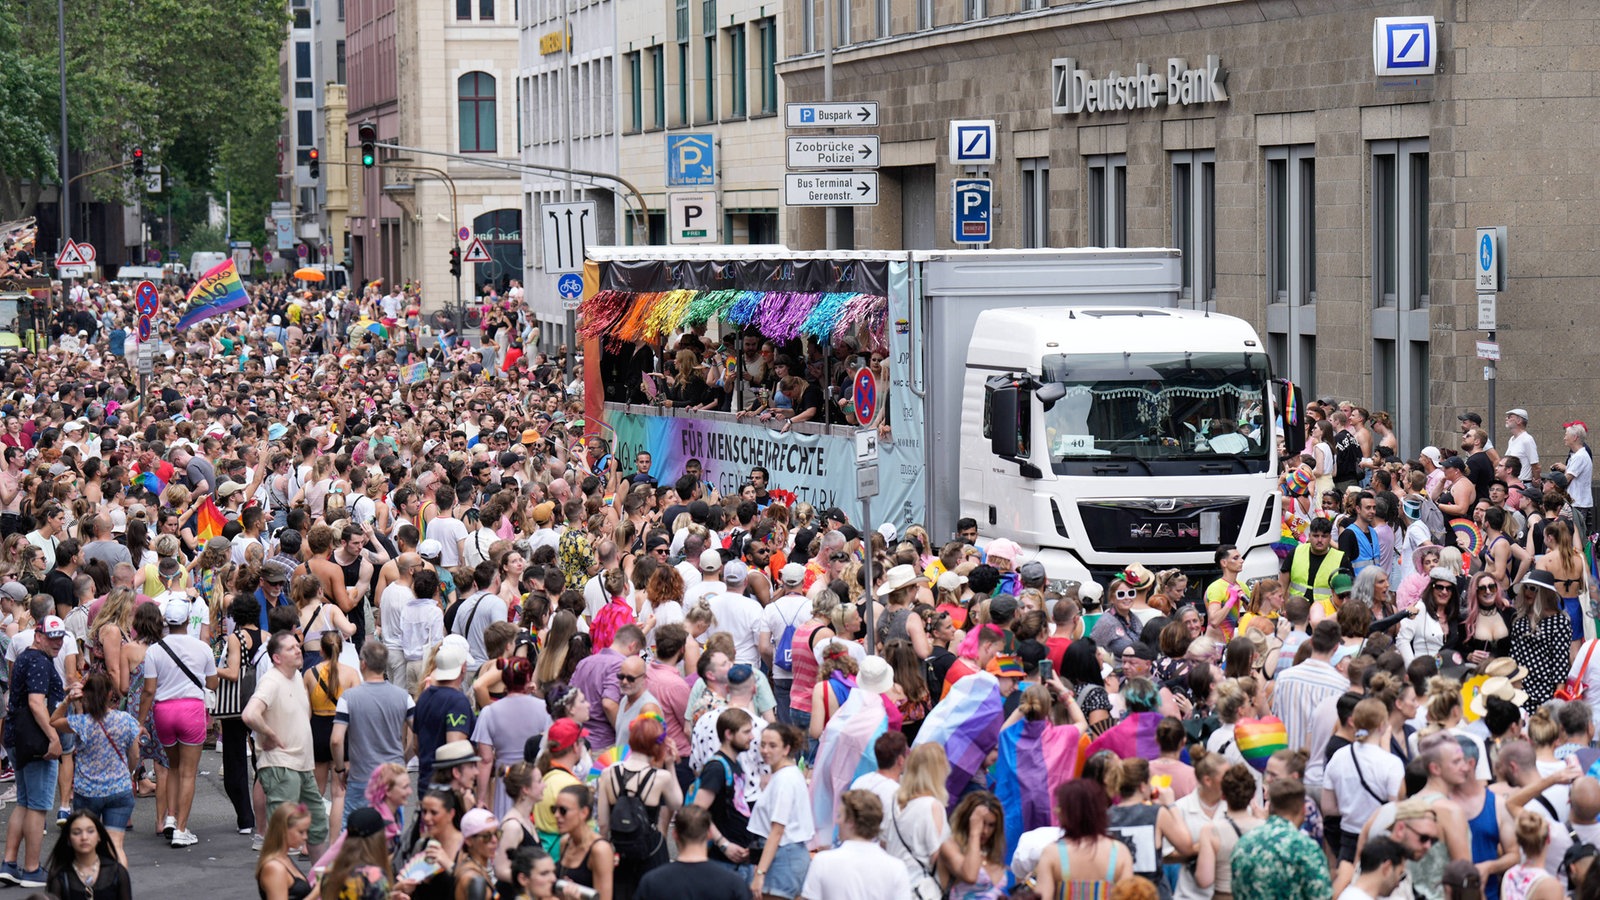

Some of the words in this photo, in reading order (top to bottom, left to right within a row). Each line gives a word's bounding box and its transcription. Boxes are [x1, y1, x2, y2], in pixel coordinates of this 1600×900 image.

[1073, 63, 1166, 113] Deutsche
[1168, 55, 1229, 105] Bank
[803, 110, 811, 121] P
[819, 111, 852, 122] Buspark
[796, 142, 854, 152] Zoobrücke
[680, 146, 702, 173] P
[818, 153, 854, 163] Polizei
[797, 178, 813, 188] Bus
[815, 178, 852, 187] Terminal
[808, 191, 853, 200] Gereonstr.
[964, 192, 981, 215] P
[684, 205, 702, 228] P
[682, 424, 704, 459] FÜR
[706, 432, 827, 477] MENSCHENRECHTE.
[1071, 440, 1085, 448] 40
[1130, 523, 1199, 538] MAN
